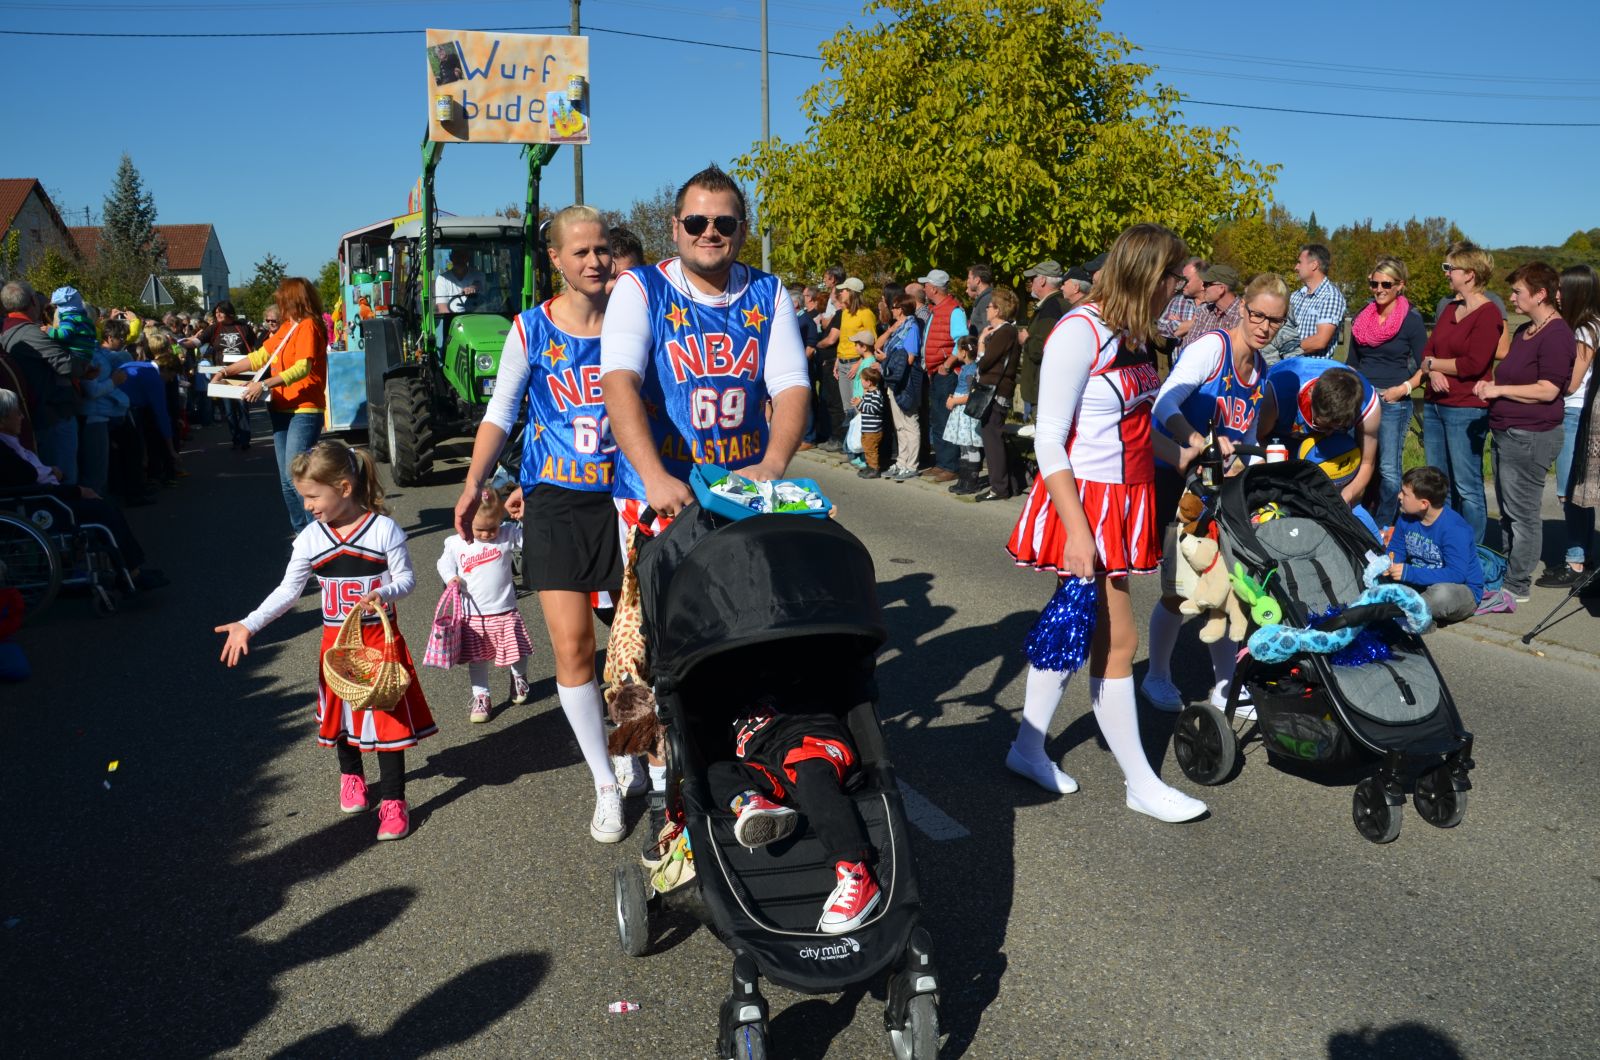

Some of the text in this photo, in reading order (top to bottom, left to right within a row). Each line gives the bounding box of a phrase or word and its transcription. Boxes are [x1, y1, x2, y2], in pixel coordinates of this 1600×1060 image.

[455, 40, 556, 83] Wurf
[462, 89, 545, 123] bude
[665, 332, 760, 384] NBA
[546, 365, 605, 412] NB
[690, 387, 747, 431] 69
[540, 455, 615, 484] ALLST
[460, 546, 499, 568] Canadian
[799, 946, 820, 960] city
[822, 942, 847, 956] mini
